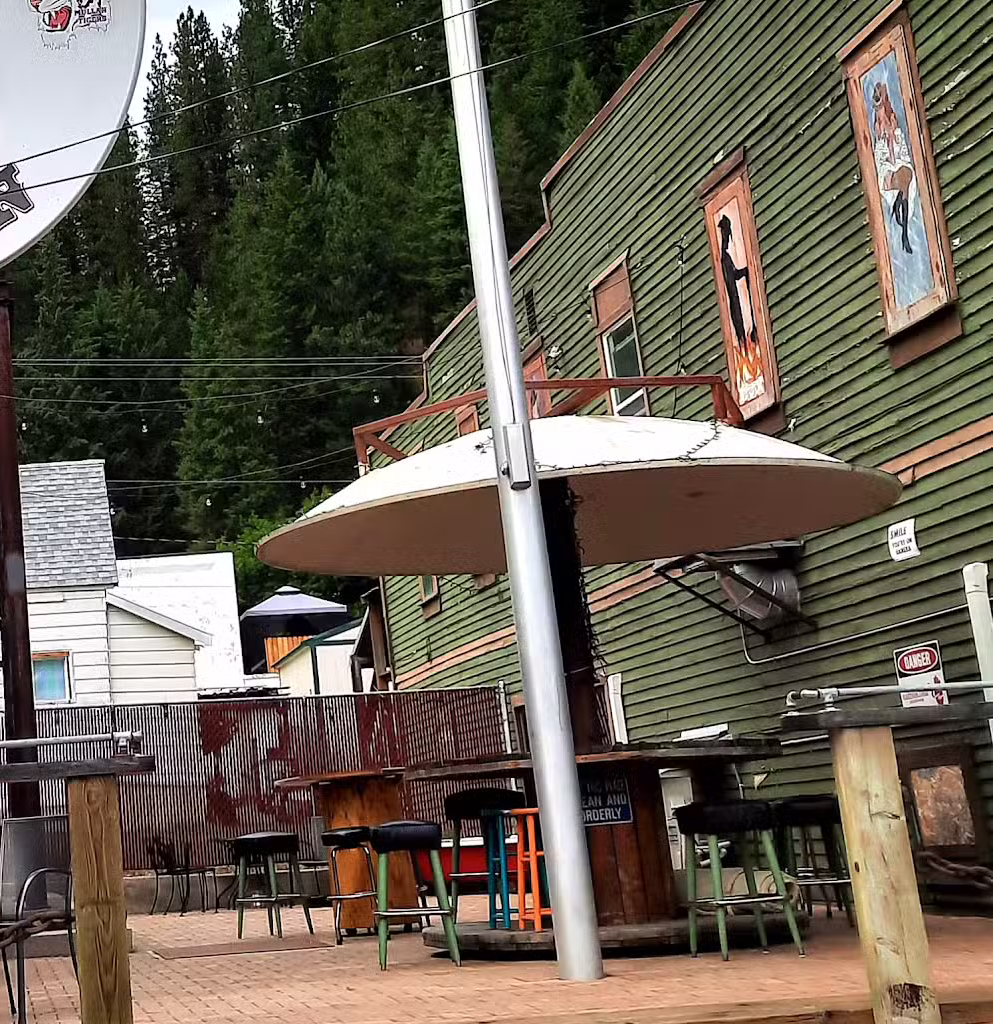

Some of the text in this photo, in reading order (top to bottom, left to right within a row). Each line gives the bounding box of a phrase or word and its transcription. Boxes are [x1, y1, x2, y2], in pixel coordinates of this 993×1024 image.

[890, 526, 907, 540] SMILE
[903, 651, 932, 670] DANGER
[581, 793, 627, 808] EAN AND
